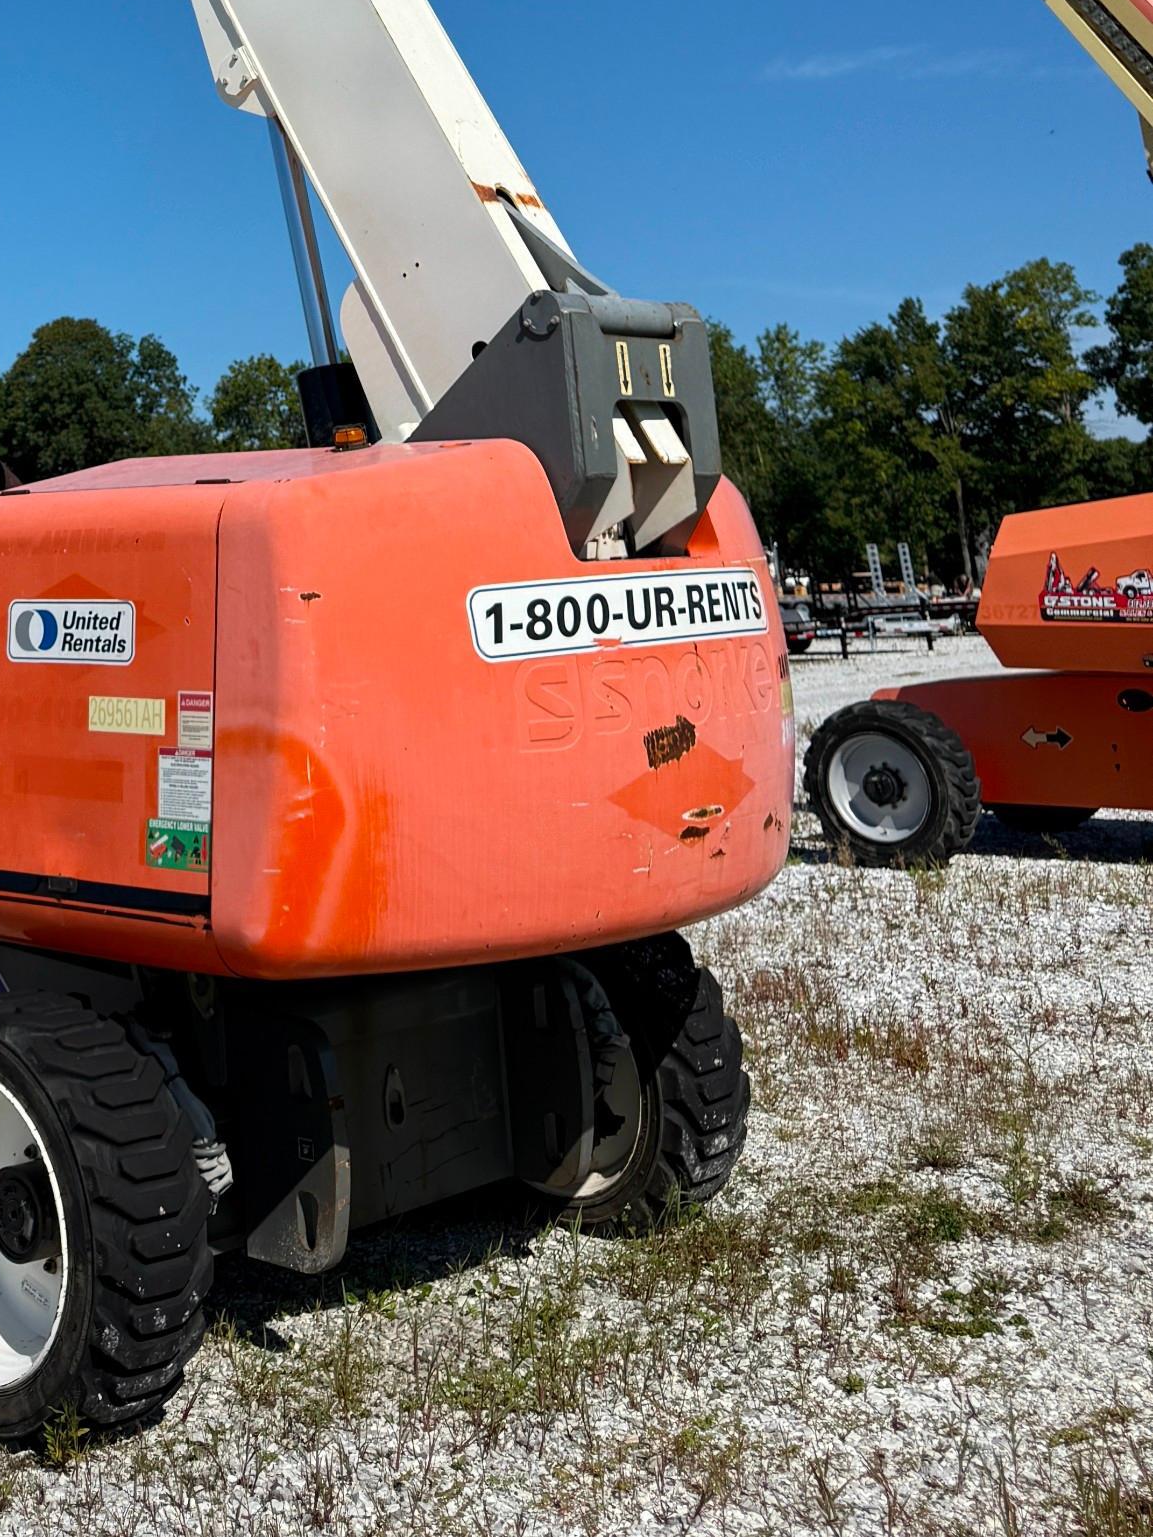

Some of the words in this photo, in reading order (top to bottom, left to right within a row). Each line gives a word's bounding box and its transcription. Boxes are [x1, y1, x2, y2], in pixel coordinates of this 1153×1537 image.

[63, 610, 121, 630] United
[484, 579, 763, 645] 1-800-UR-RENTS
[61, 632, 127, 654] Rentals
[89, 697, 163, 729] 269561AH
[185, 698, 211, 707] DANGER
[149, 818, 176, 830] EMERGENCY
[177, 821, 193, 831] LOWER
[194, 823, 209, 833] VALVE
